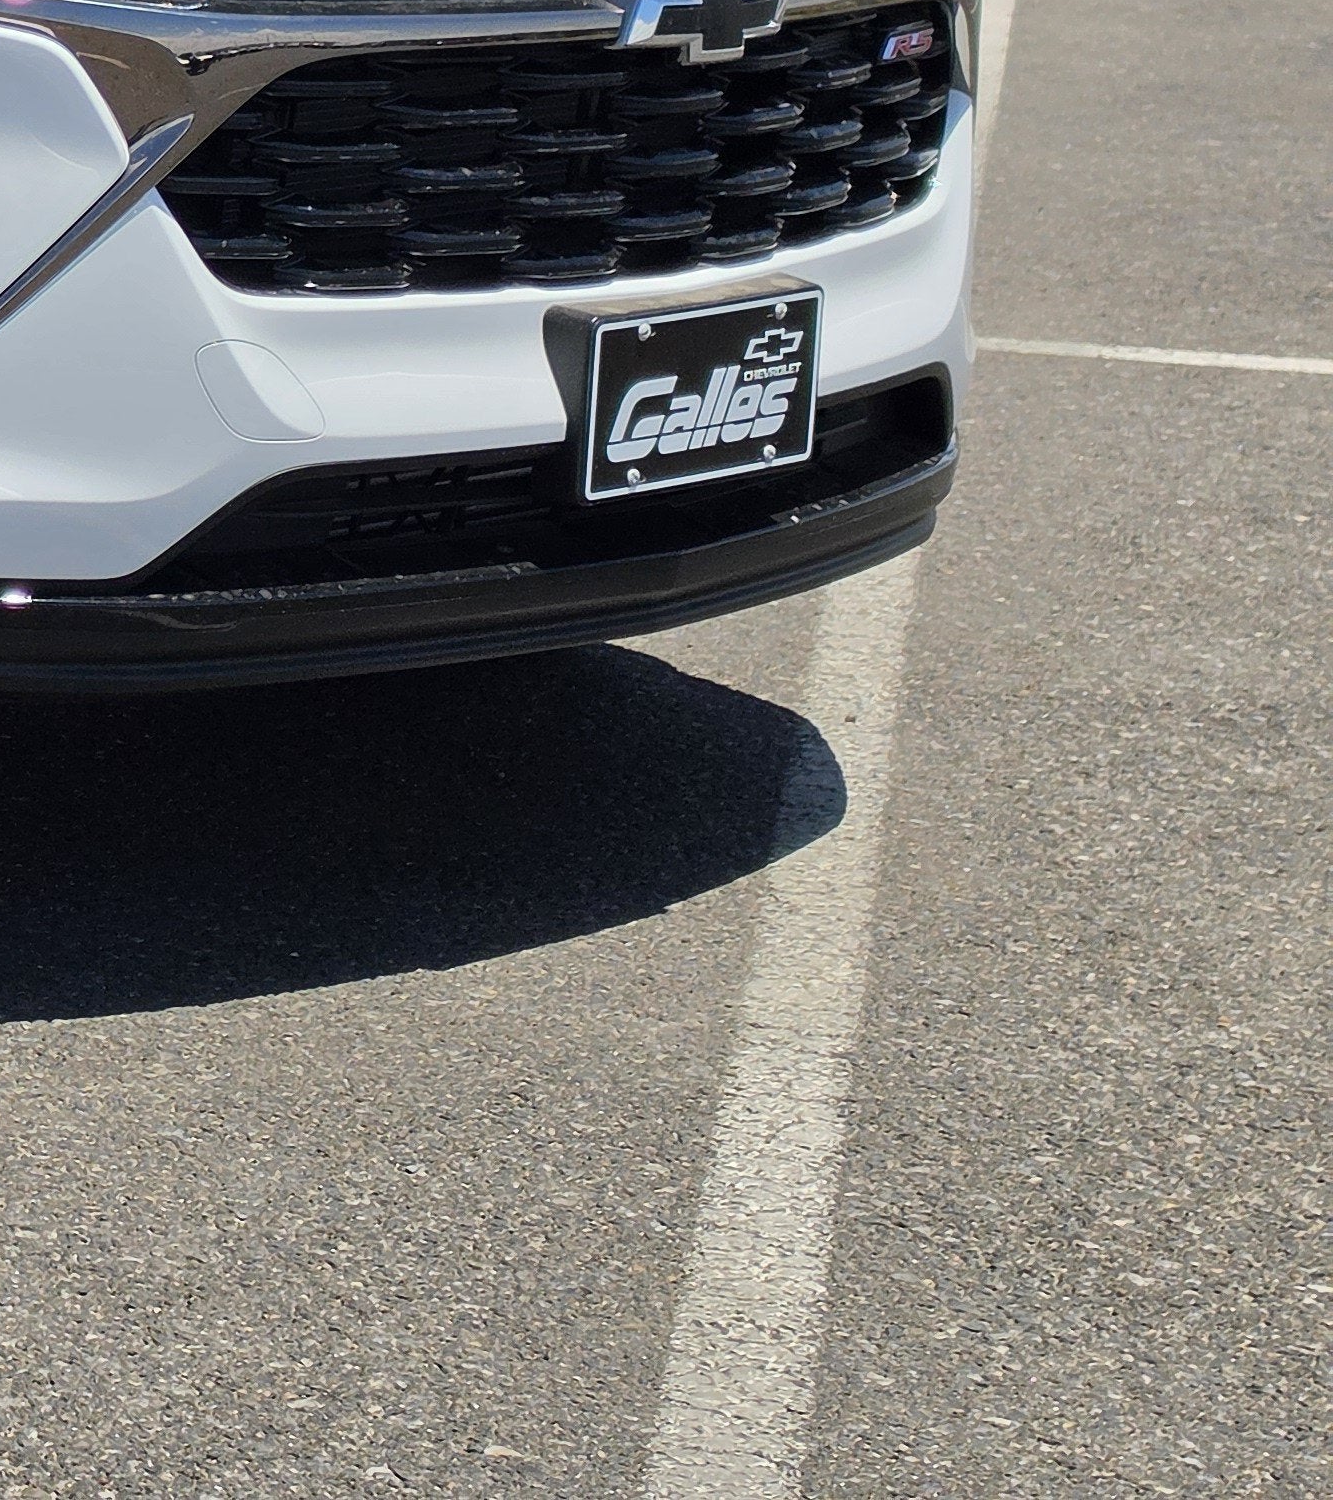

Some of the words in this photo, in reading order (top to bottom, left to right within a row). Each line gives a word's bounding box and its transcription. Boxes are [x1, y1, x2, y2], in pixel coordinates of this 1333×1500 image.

[882, 27, 935, 61] RS
[743, 362, 802, 382] CHEVROLET
[606, 364, 798, 463] Galles
